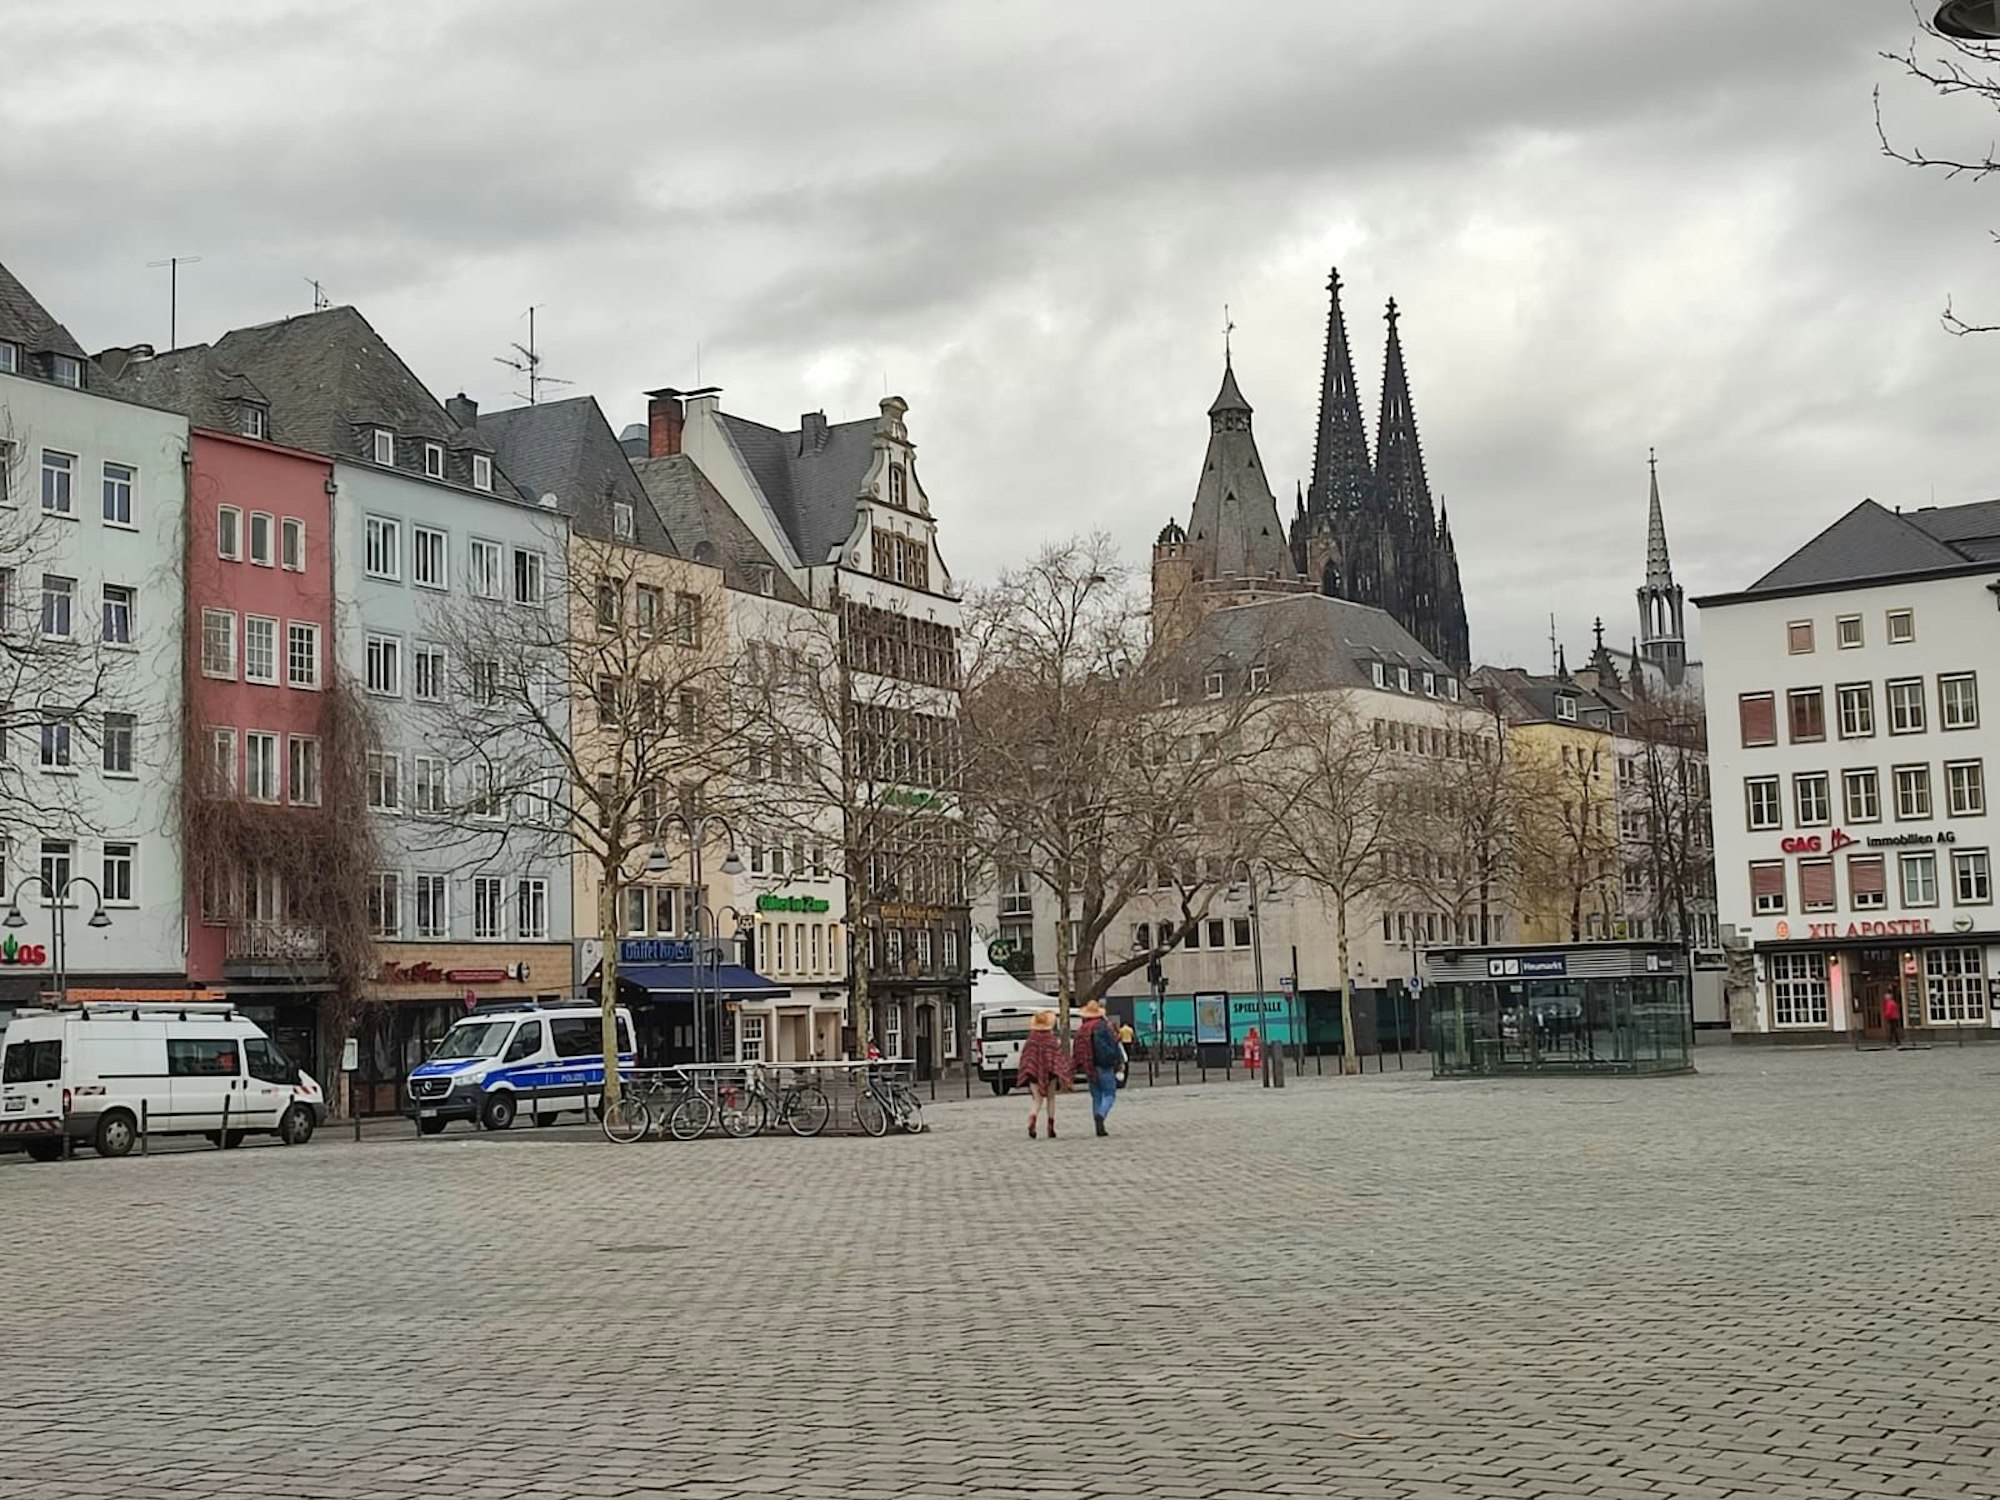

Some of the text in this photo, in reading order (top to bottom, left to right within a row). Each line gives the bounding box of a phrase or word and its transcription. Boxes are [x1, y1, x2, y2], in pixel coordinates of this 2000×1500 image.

[1781, 831, 1956, 853] GAG Immobilien AG
[1808, 919, 1935, 939] XII APOSTEL
[1523, 961, 1563, 971] Heumarkt
[560, 1072, 586, 1082] POLIZEI
